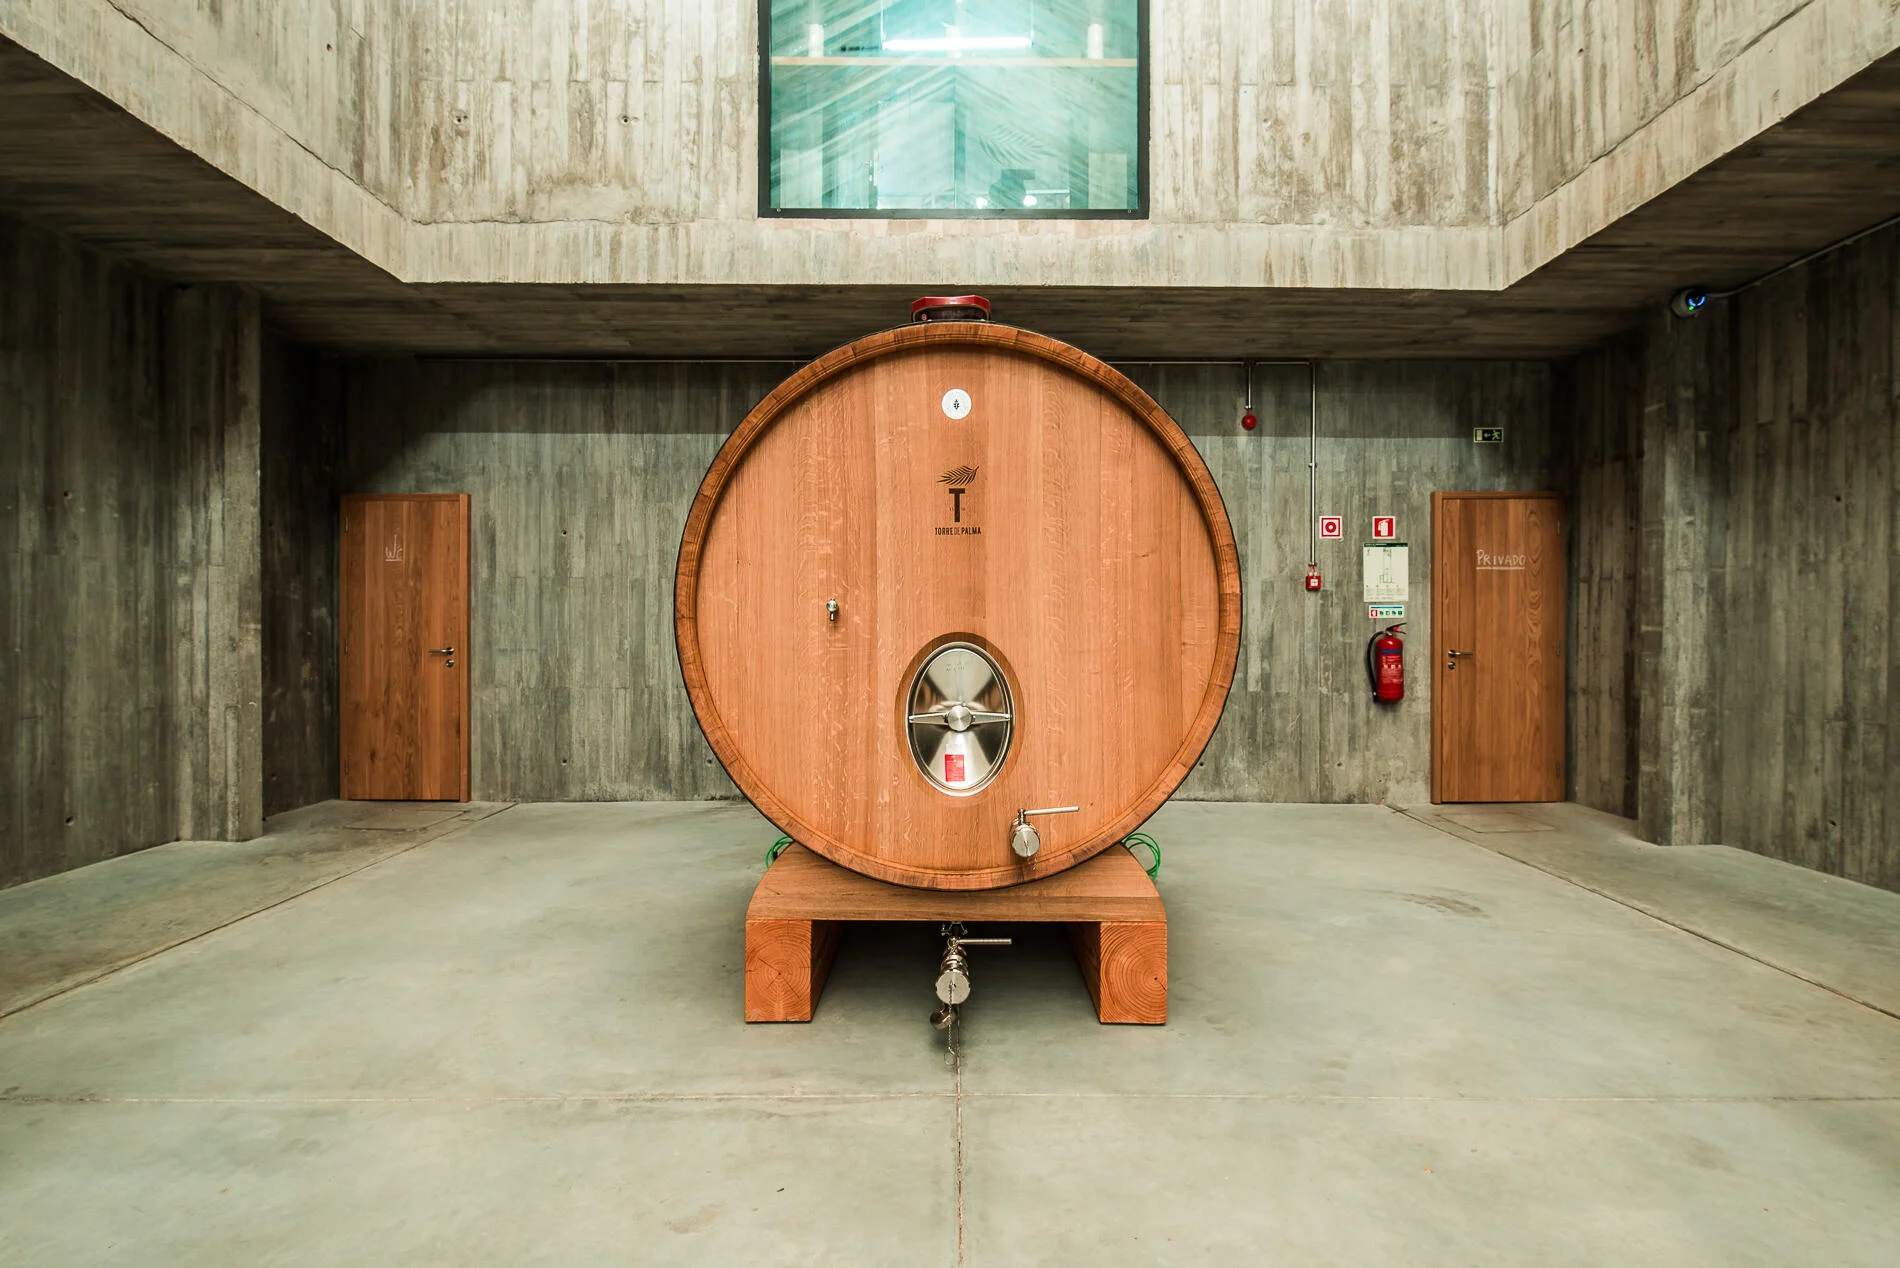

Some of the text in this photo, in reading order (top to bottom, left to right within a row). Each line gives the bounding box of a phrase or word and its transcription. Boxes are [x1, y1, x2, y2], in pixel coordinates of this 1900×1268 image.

[949, 488, 965, 522] T
[934, 526, 982, 536] TORRE DE PALMA
